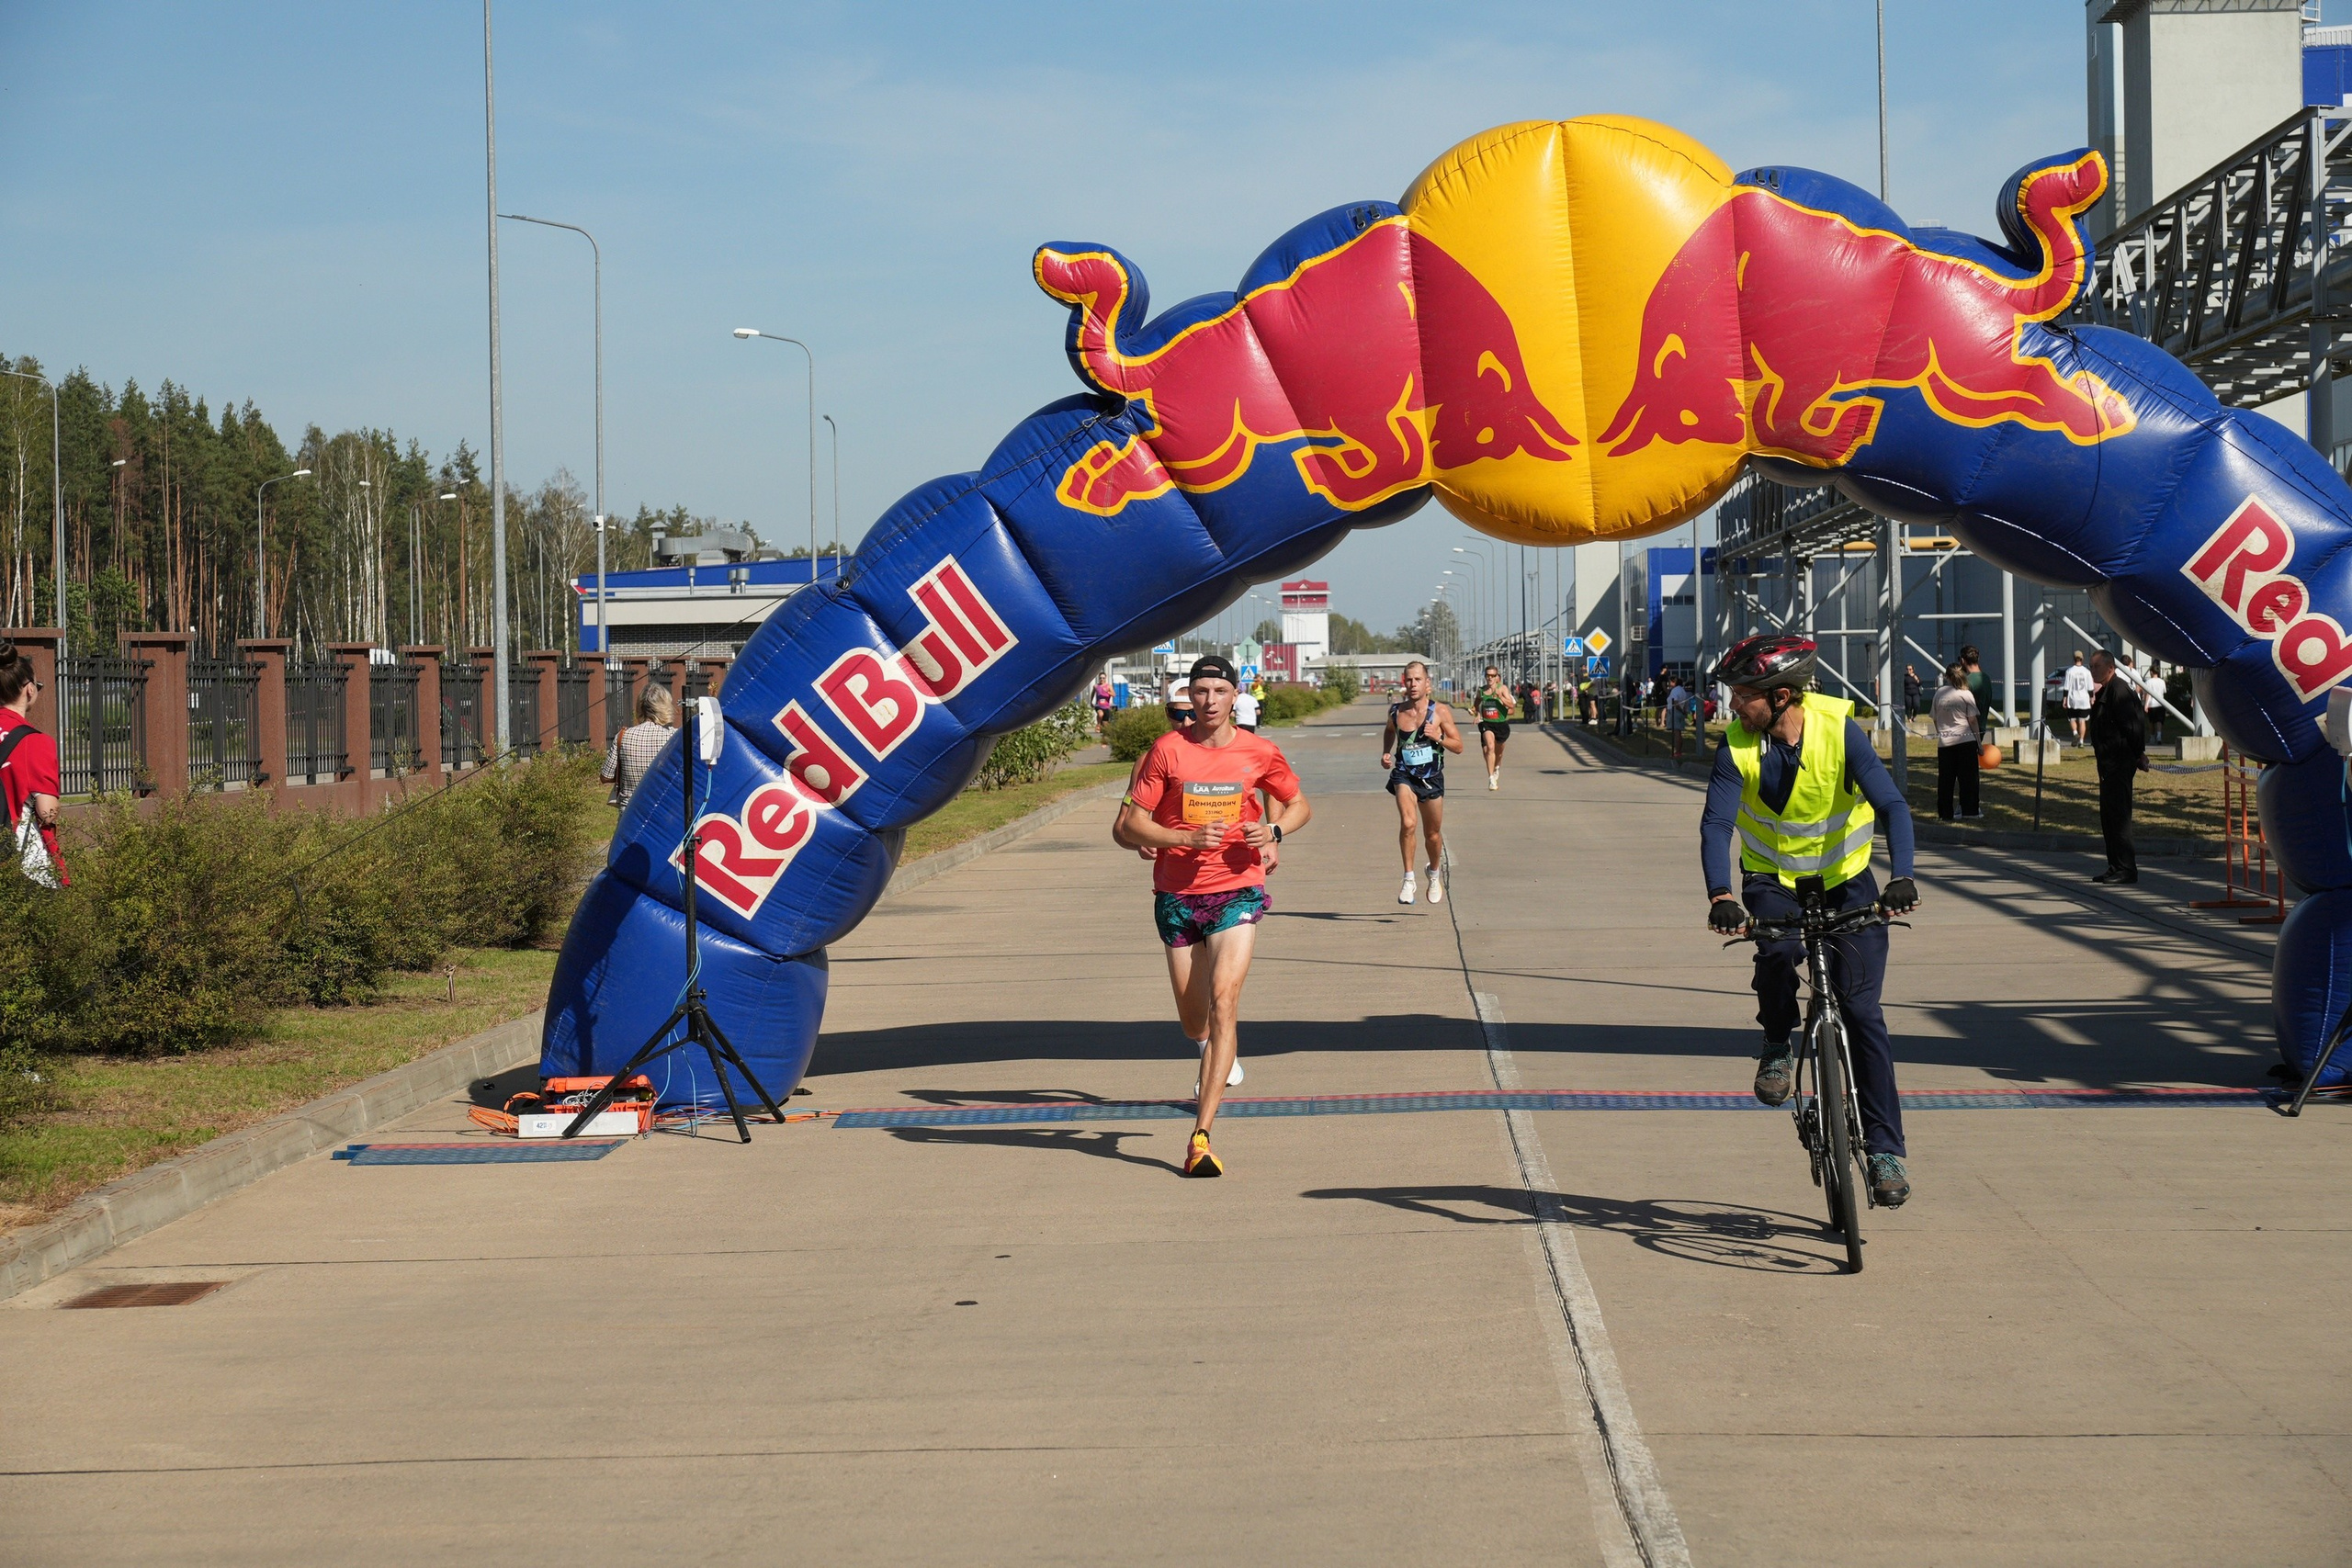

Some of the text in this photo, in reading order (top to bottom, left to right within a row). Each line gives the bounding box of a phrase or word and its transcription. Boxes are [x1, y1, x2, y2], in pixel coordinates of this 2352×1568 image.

[2185, 498, 2352, 696] Red
[673, 560, 1013, 914] Red Bull
[1189, 799, 1236, 807] Демидович
